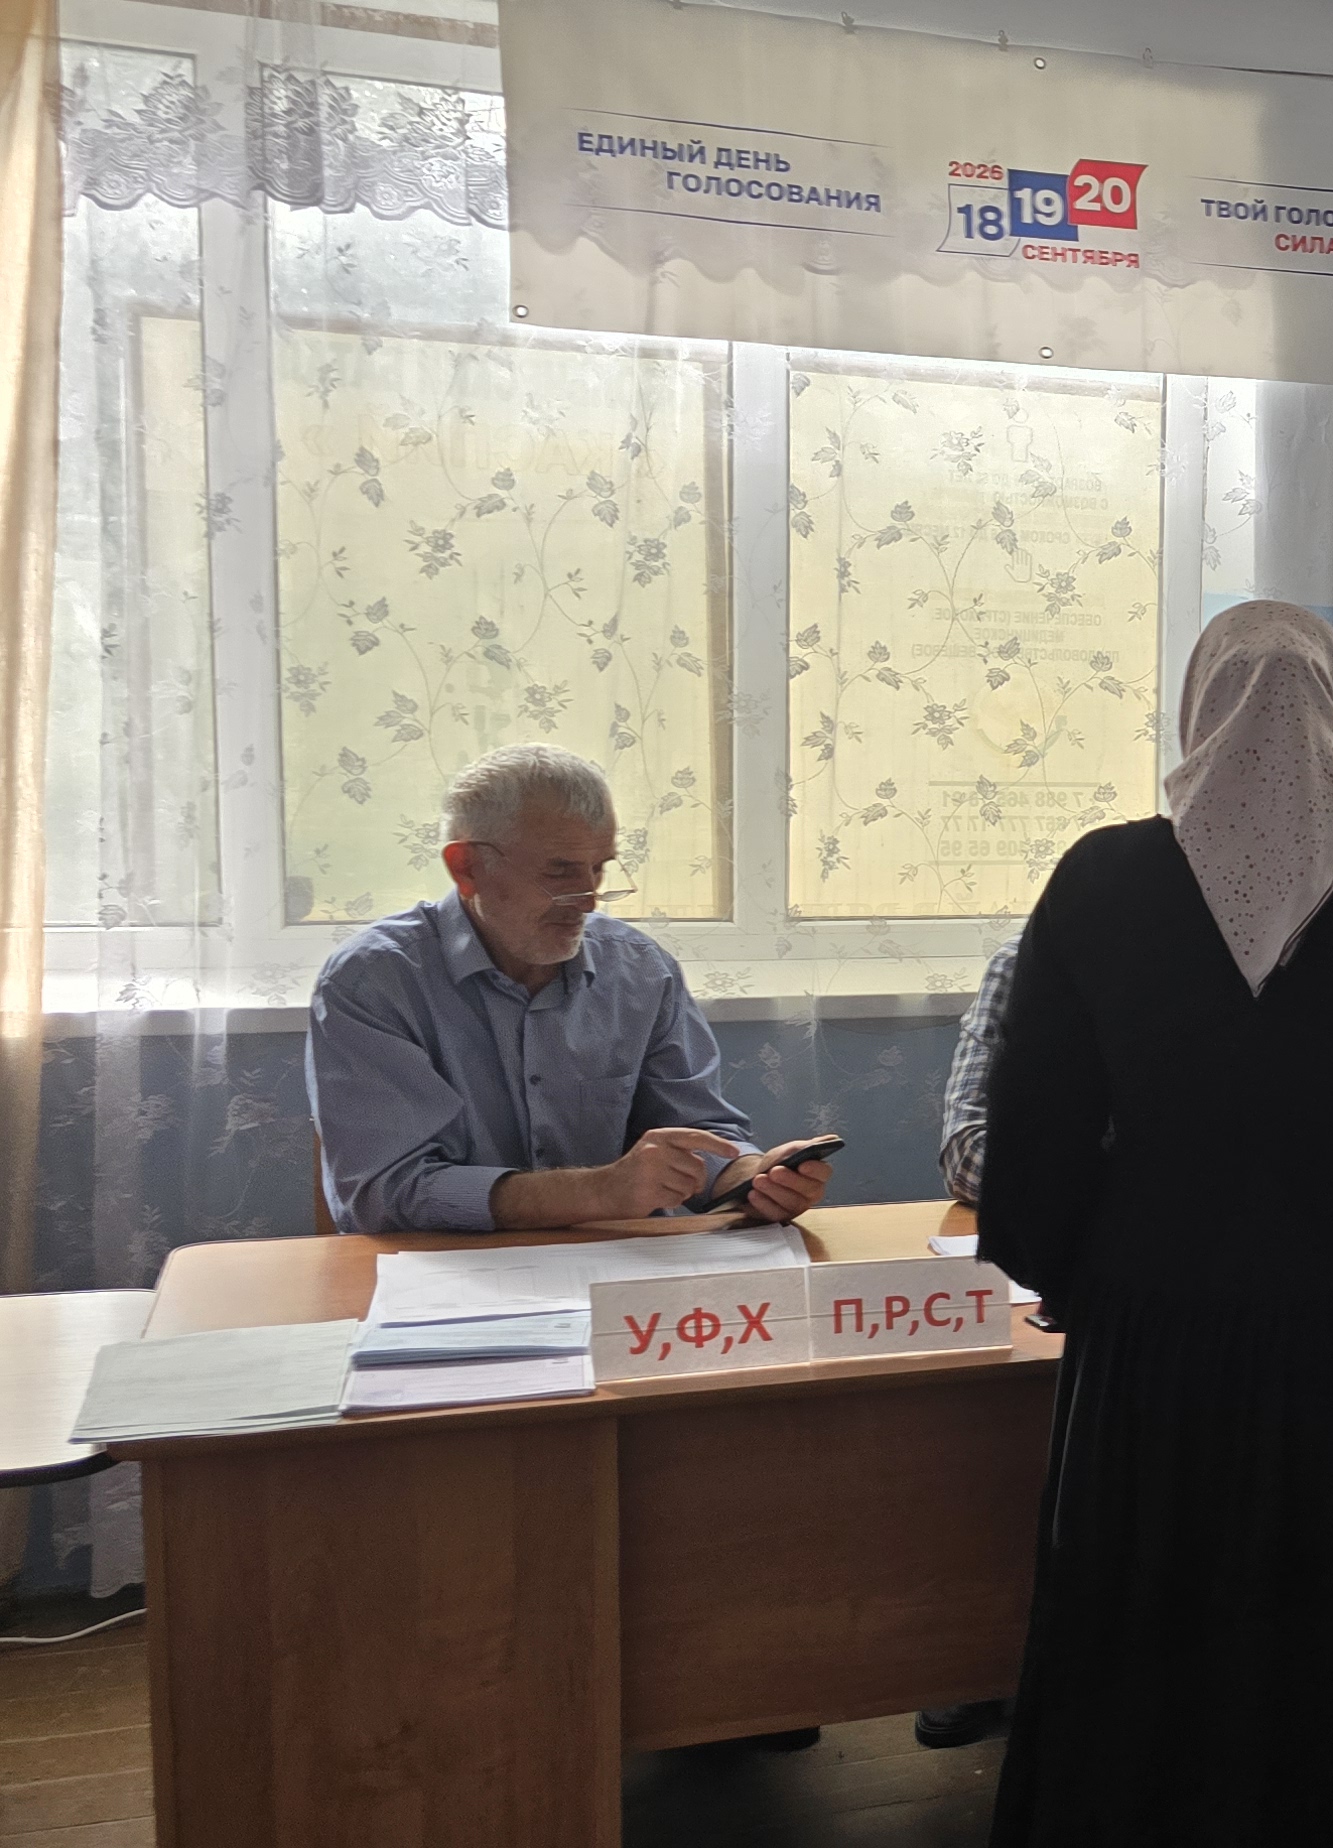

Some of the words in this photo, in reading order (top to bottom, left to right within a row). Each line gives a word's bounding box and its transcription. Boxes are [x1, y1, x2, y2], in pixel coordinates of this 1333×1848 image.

[577, 131, 707, 165] ЕДИНЫЙ
[713, 146, 791, 173] ДЕНЬ
[950, 160, 1004, 181] 2026
[666, 170, 882, 213] ГОЛОСОВАНИЯ
[956, 203, 1005, 242] 18
[1014, 187, 1064, 226] 19
[1073, 174, 1132, 214] 20
[1200, 198, 1269, 223] ТВОЙ
[1022, 243, 1141, 269] СЕНТЯБРЯ
[623, 1301, 774, 1362] У,Ф,Х
[832, 1288, 995, 1339] П,Р,С,Т
